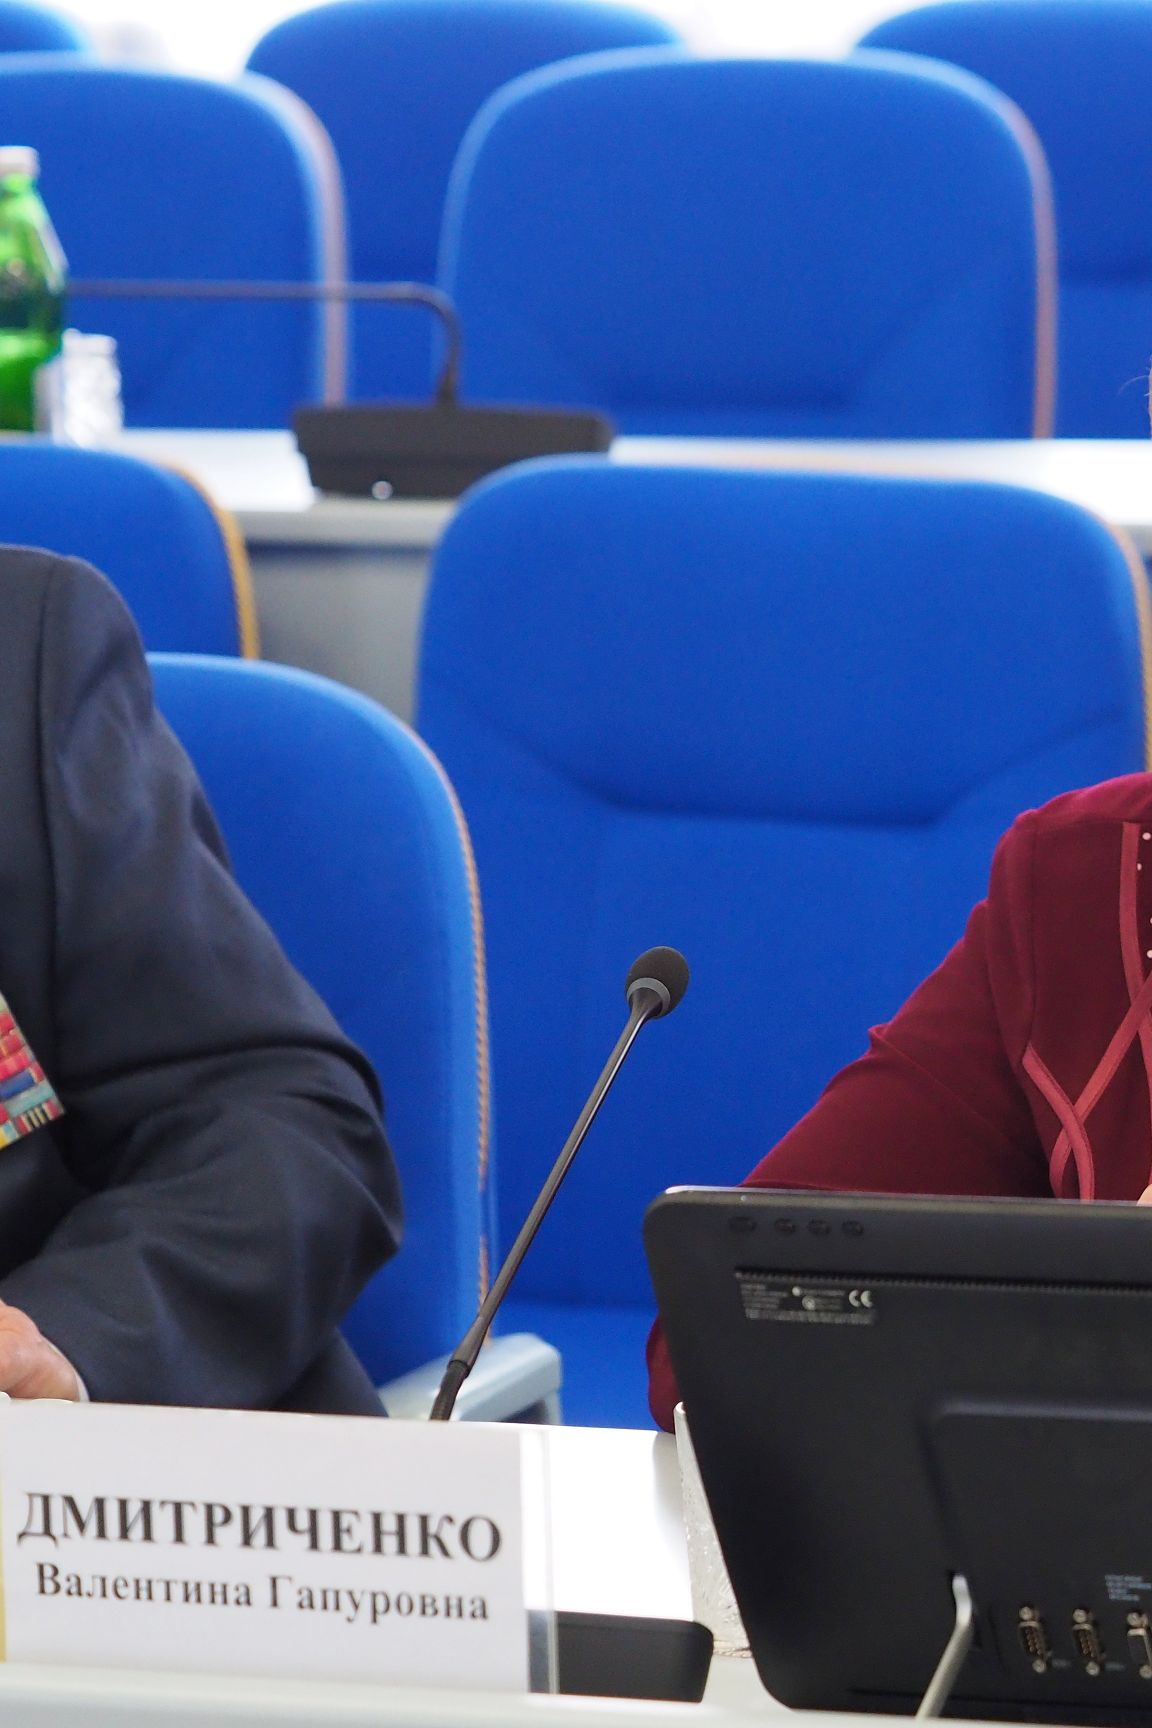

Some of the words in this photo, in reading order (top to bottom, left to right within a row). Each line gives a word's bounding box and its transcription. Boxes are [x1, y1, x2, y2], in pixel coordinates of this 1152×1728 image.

[17, 1492, 502, 1563] ДМИТРИЧЕНКО
[35, 1563, 254, 1609] Валентина
[269, 1576, 489, 1625] Гапуровна
